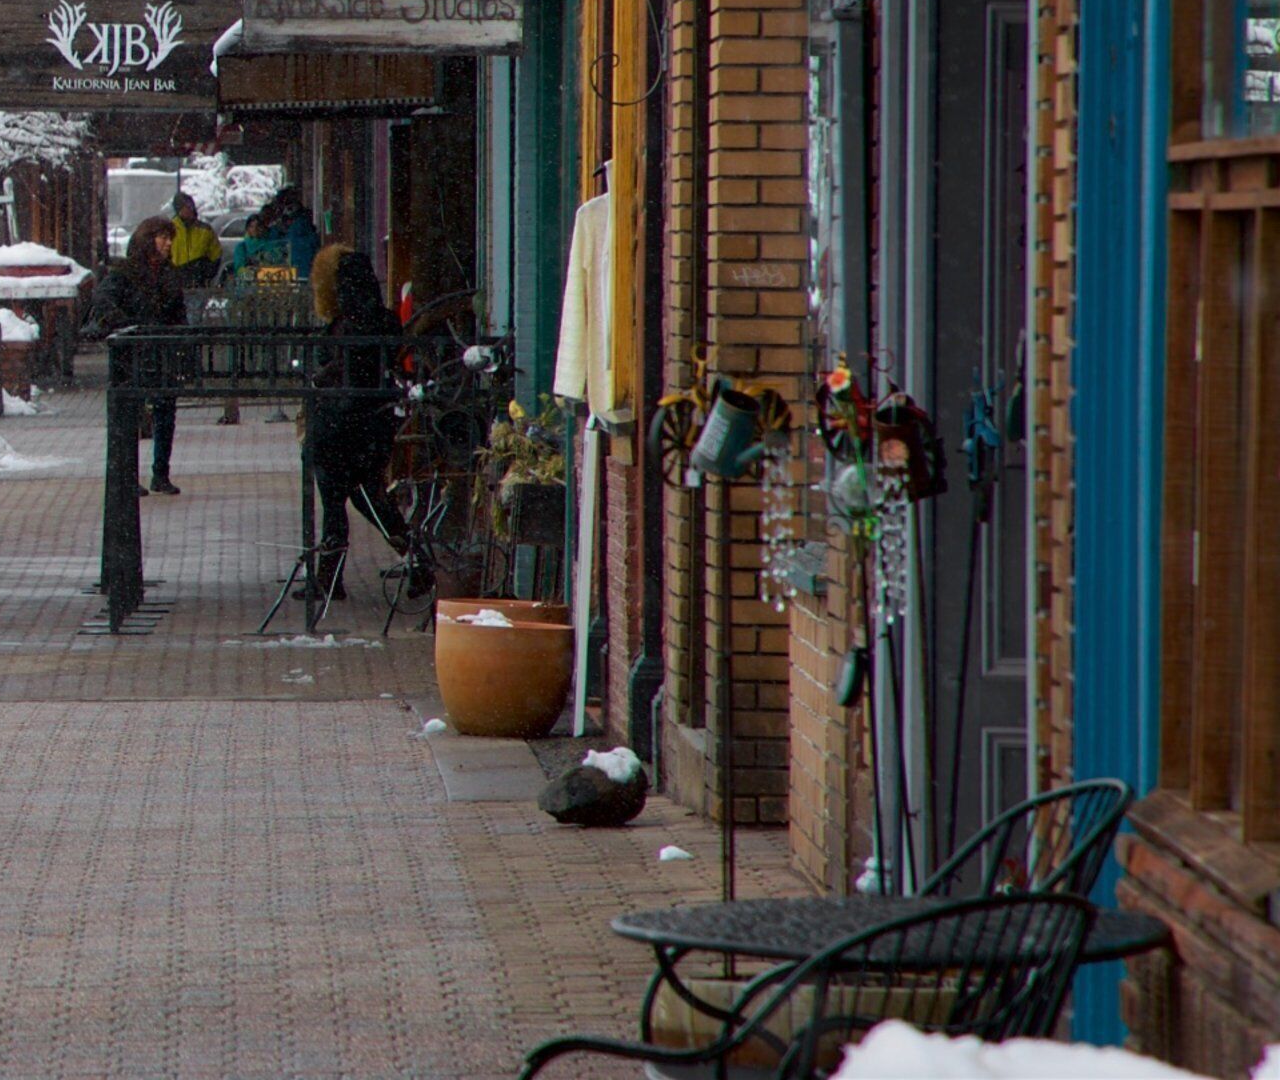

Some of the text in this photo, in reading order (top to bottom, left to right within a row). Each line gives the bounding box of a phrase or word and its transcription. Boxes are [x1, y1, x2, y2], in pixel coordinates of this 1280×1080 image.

[52, 77, 176, 93] KALIFORNIA JEAN BAR
